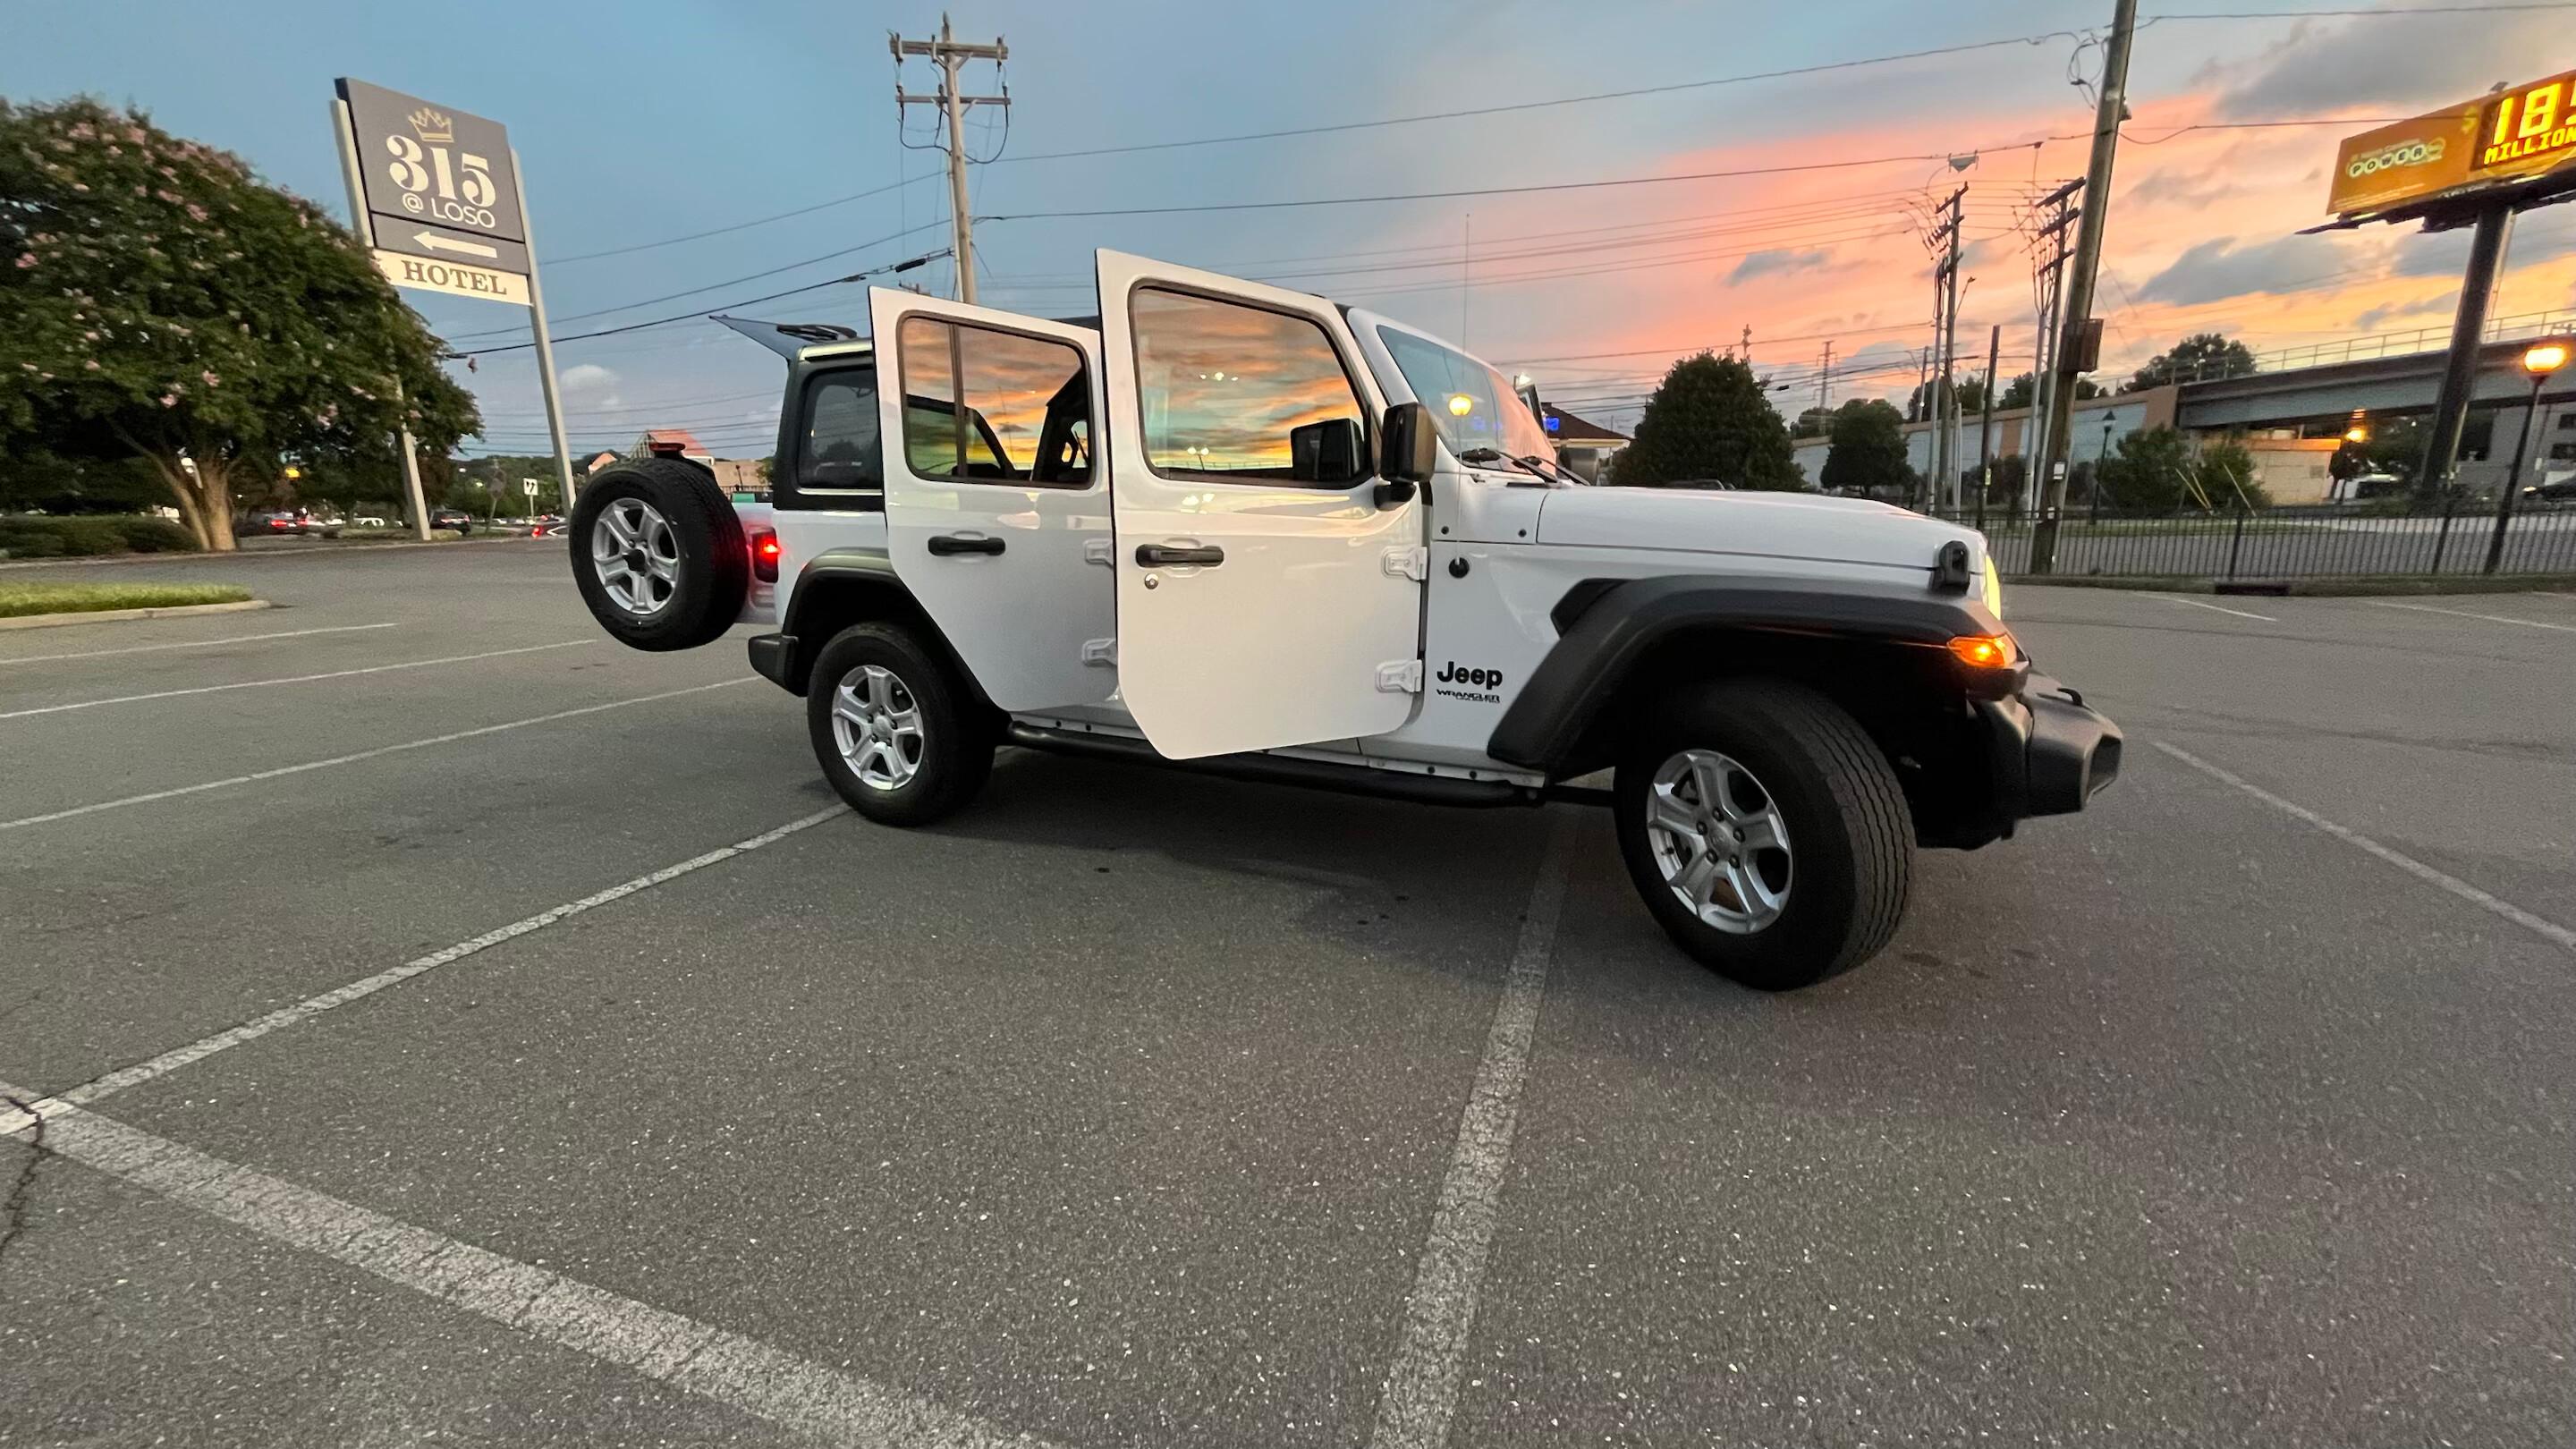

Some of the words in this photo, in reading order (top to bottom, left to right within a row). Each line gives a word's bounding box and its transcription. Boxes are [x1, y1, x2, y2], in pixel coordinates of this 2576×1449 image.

[2484, 126, 2576, 165] MILLION
[386, 134, 496, 208] 315
[402, 192, 424, 213] @
[431, 198, 496, 228] LOSO
[401, 259, 507, 295] HOTEL
[1436, 661, 1503, 691] Jeep
[1436, 689, 1501, 702] WRANGLER
